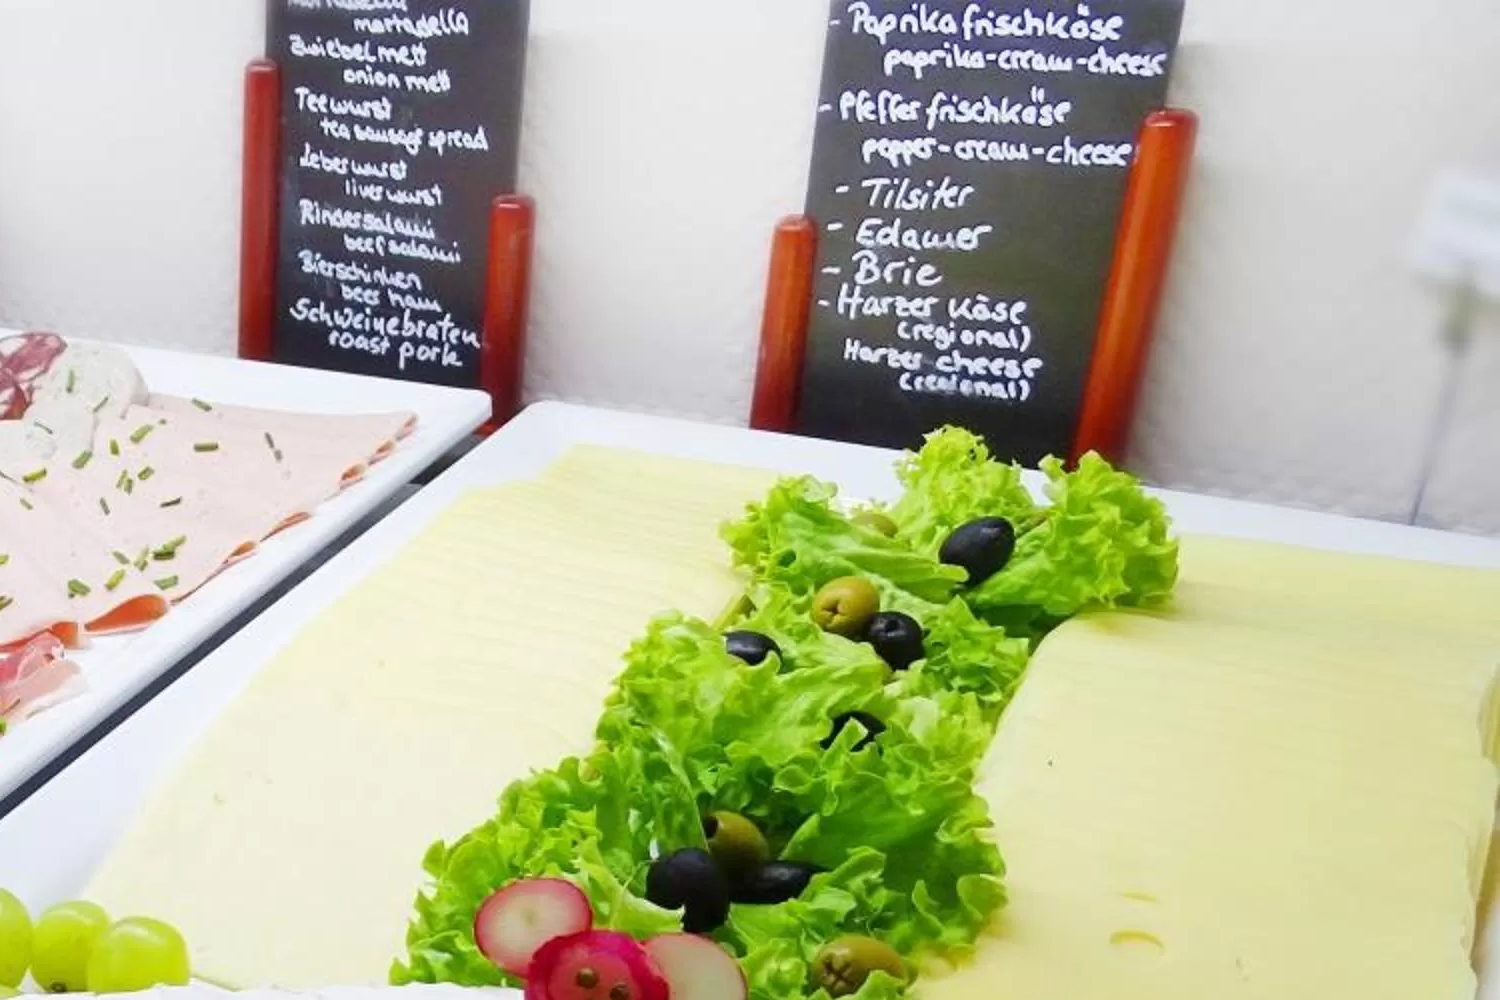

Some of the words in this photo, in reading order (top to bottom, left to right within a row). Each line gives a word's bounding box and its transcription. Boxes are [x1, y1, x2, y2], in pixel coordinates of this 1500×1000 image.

[343, 65, 400, 88] onion
[320, 117, 350, 141] tea
[428, 125, 489, 156] spread
[862, 176, 975, 210] Tilsiter
[856, 218, 993, 251] Edamer
[852, 250, 943, 286] Brie
[837, 283, 939, 320] Harzer
[329, 330, 390, 355] roast
[399, 342, 463, 370] pork
[935, 350, 1043, 379] cheese
